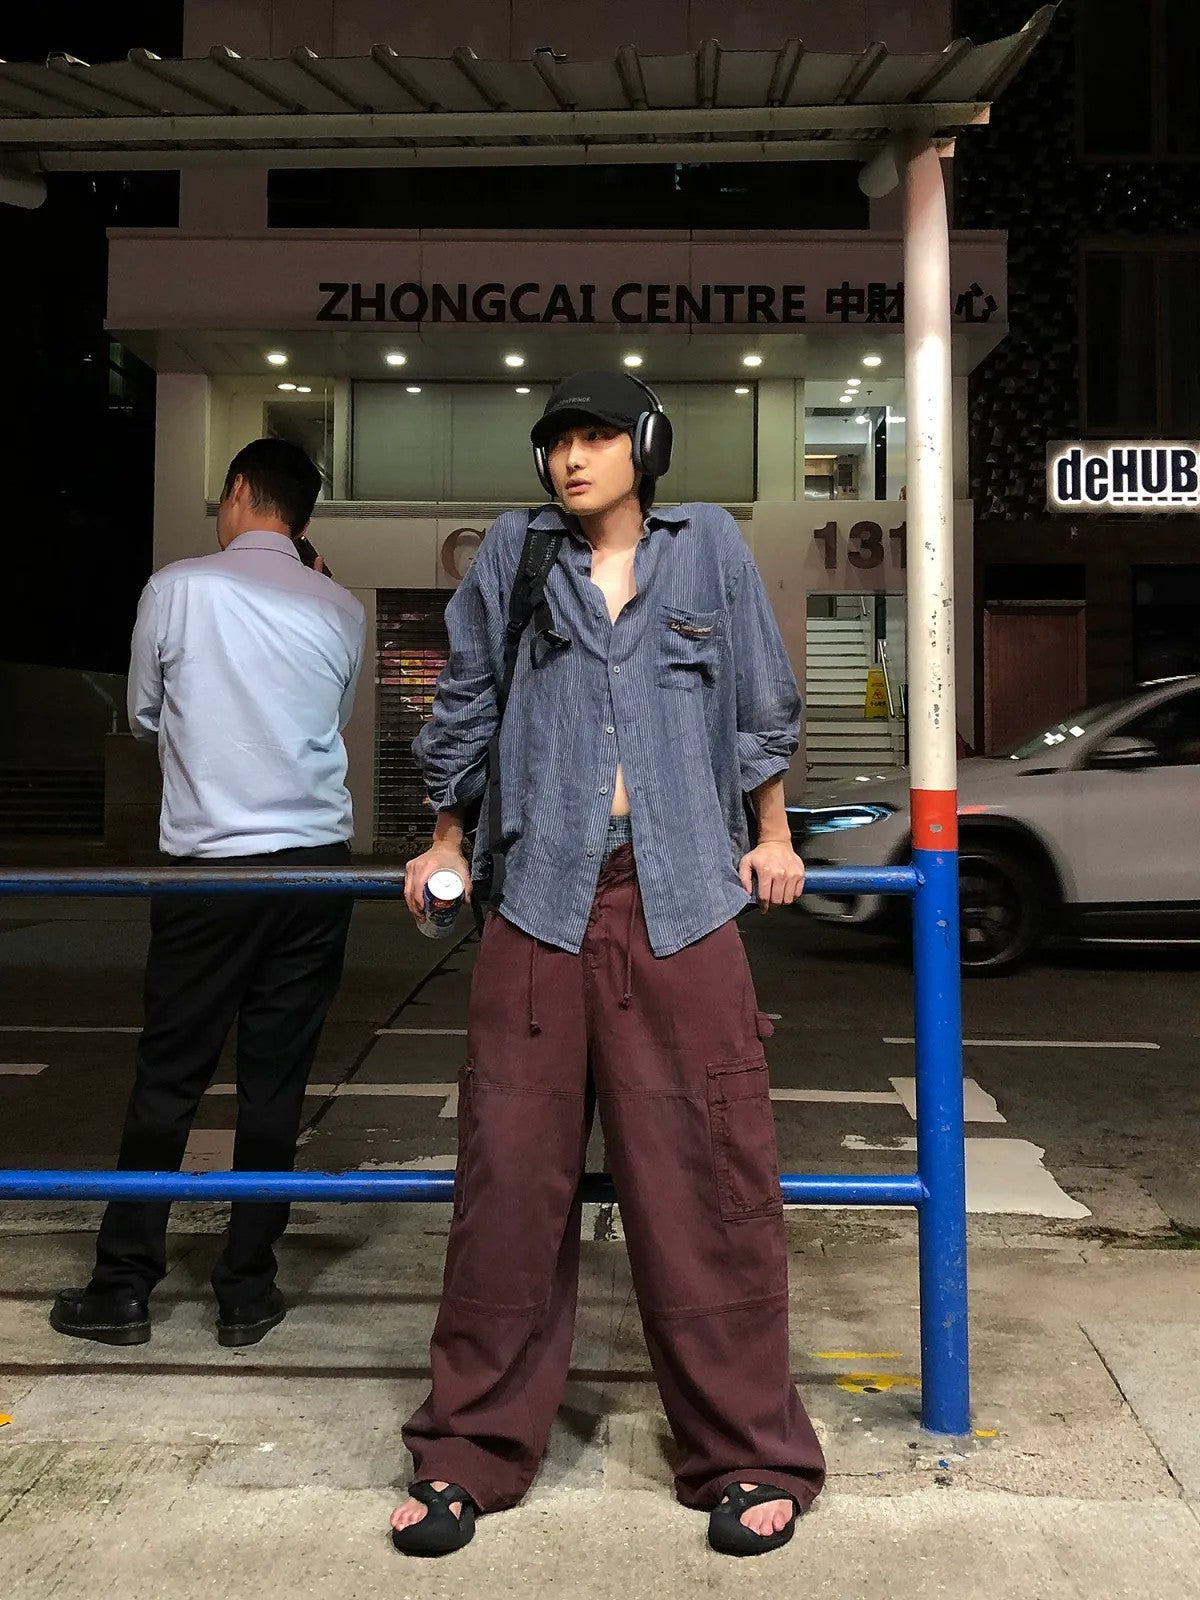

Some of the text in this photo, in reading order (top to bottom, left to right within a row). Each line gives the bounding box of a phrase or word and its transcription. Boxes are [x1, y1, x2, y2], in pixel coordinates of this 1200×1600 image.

[316, 281, 998, 323] ZHONGCAI CENTRE 中財心
[1057, 449, 1198, 501] deHUB
